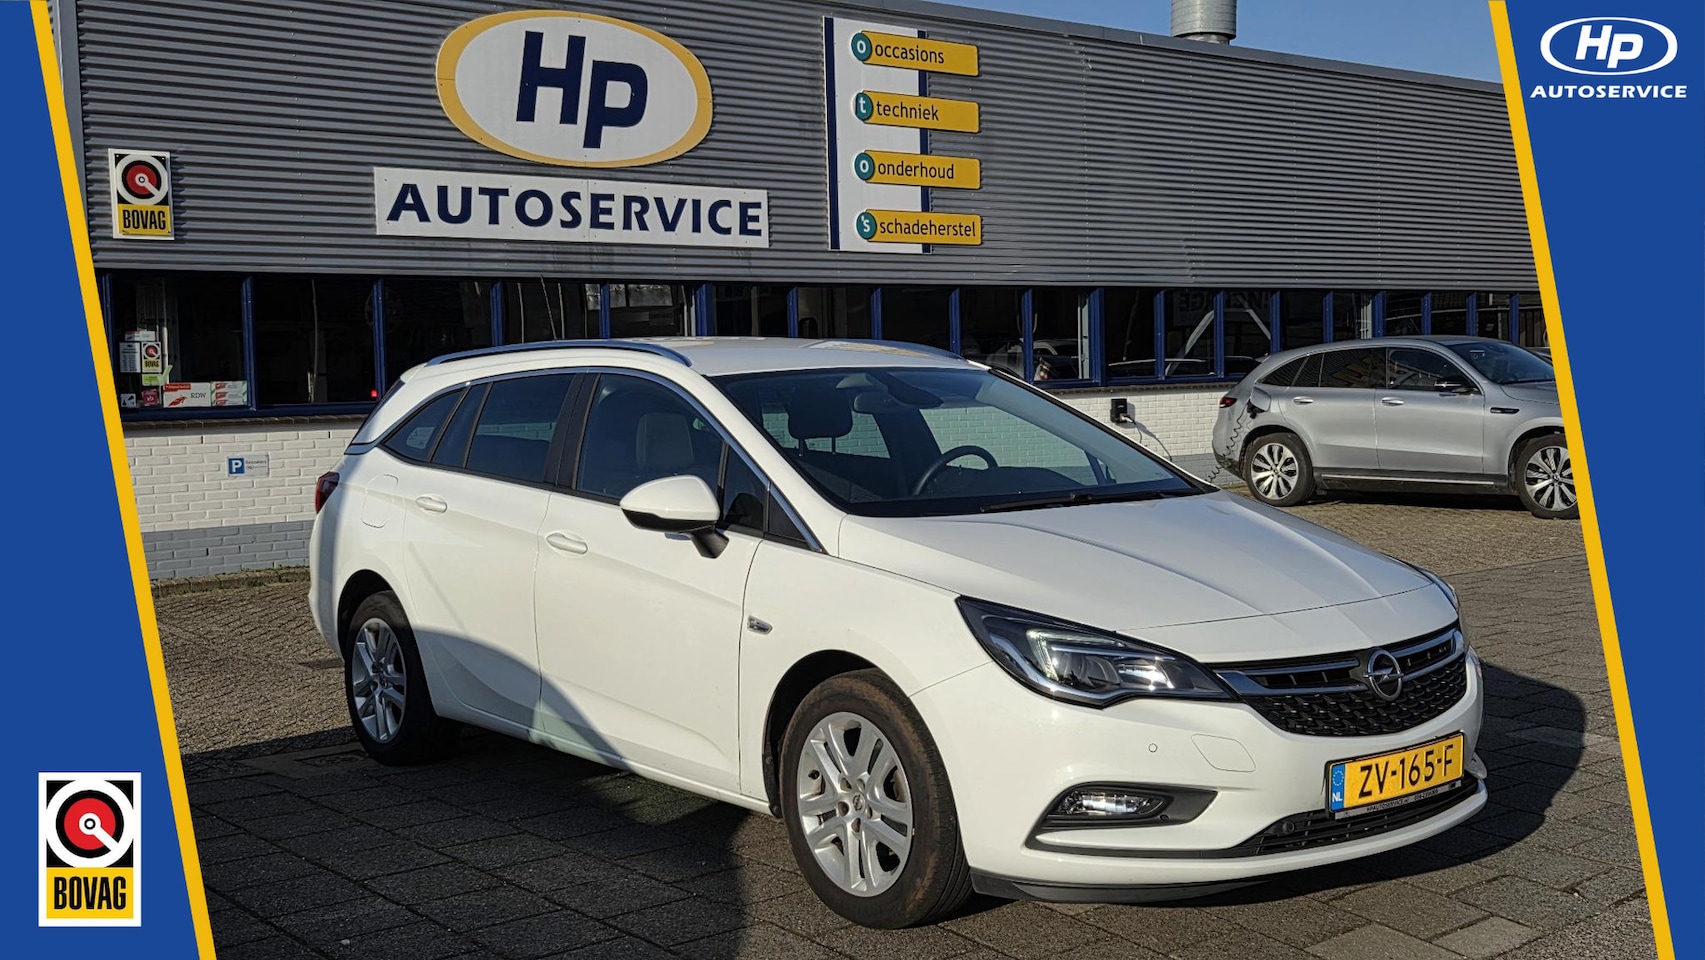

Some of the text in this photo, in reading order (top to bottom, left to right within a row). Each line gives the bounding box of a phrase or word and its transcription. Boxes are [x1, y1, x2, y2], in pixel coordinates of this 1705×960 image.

[875, 45, 945, 64] occasions
[516, 31, 648, 149] Hp
[876, 101, 939, 121] techniek
[877, 161, 954, 180] onderhoud
[122, 208, 166, 230] BOVAG
[386, 183, 762, 237] AUTOSERVICE
[879, 220, 976, 237] schadeherstel
[144, 360, 159, 368] BOVAG
[232, 460, 242, 472] P
[1358, 744, 1454, 798] ZV-165-F
[1332, 790, 1343, 803] NL
